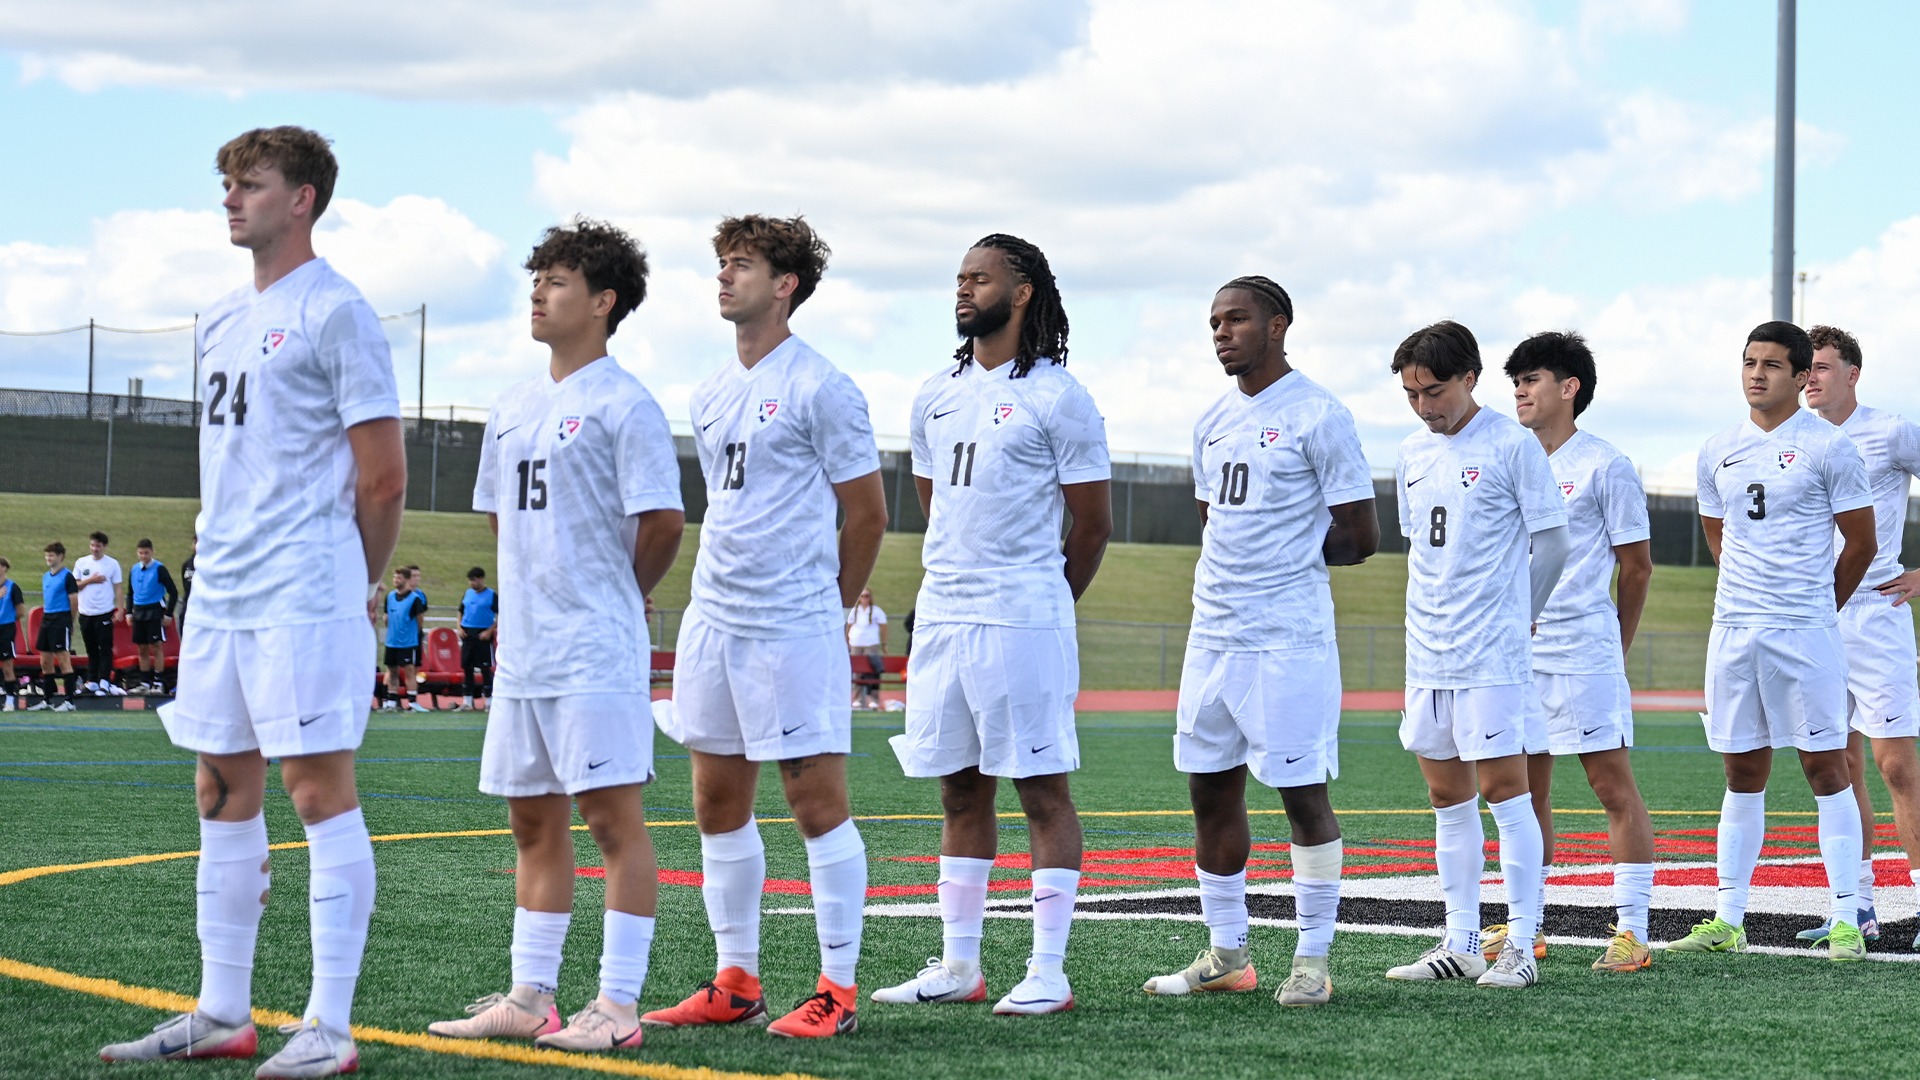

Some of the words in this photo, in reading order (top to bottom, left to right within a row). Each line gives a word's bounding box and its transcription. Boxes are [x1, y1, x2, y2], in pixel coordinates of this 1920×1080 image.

[209, 372, 247, 426] 24
[517, 459, 546, 510] 15
[723, 442, 746, 489] 13
[951, 442, 976, 486] 11
[1219, 461, 1248, 505] 10
[1747, 483, 1766, 520] 3
[1430, 506, 1446, 547] 8
